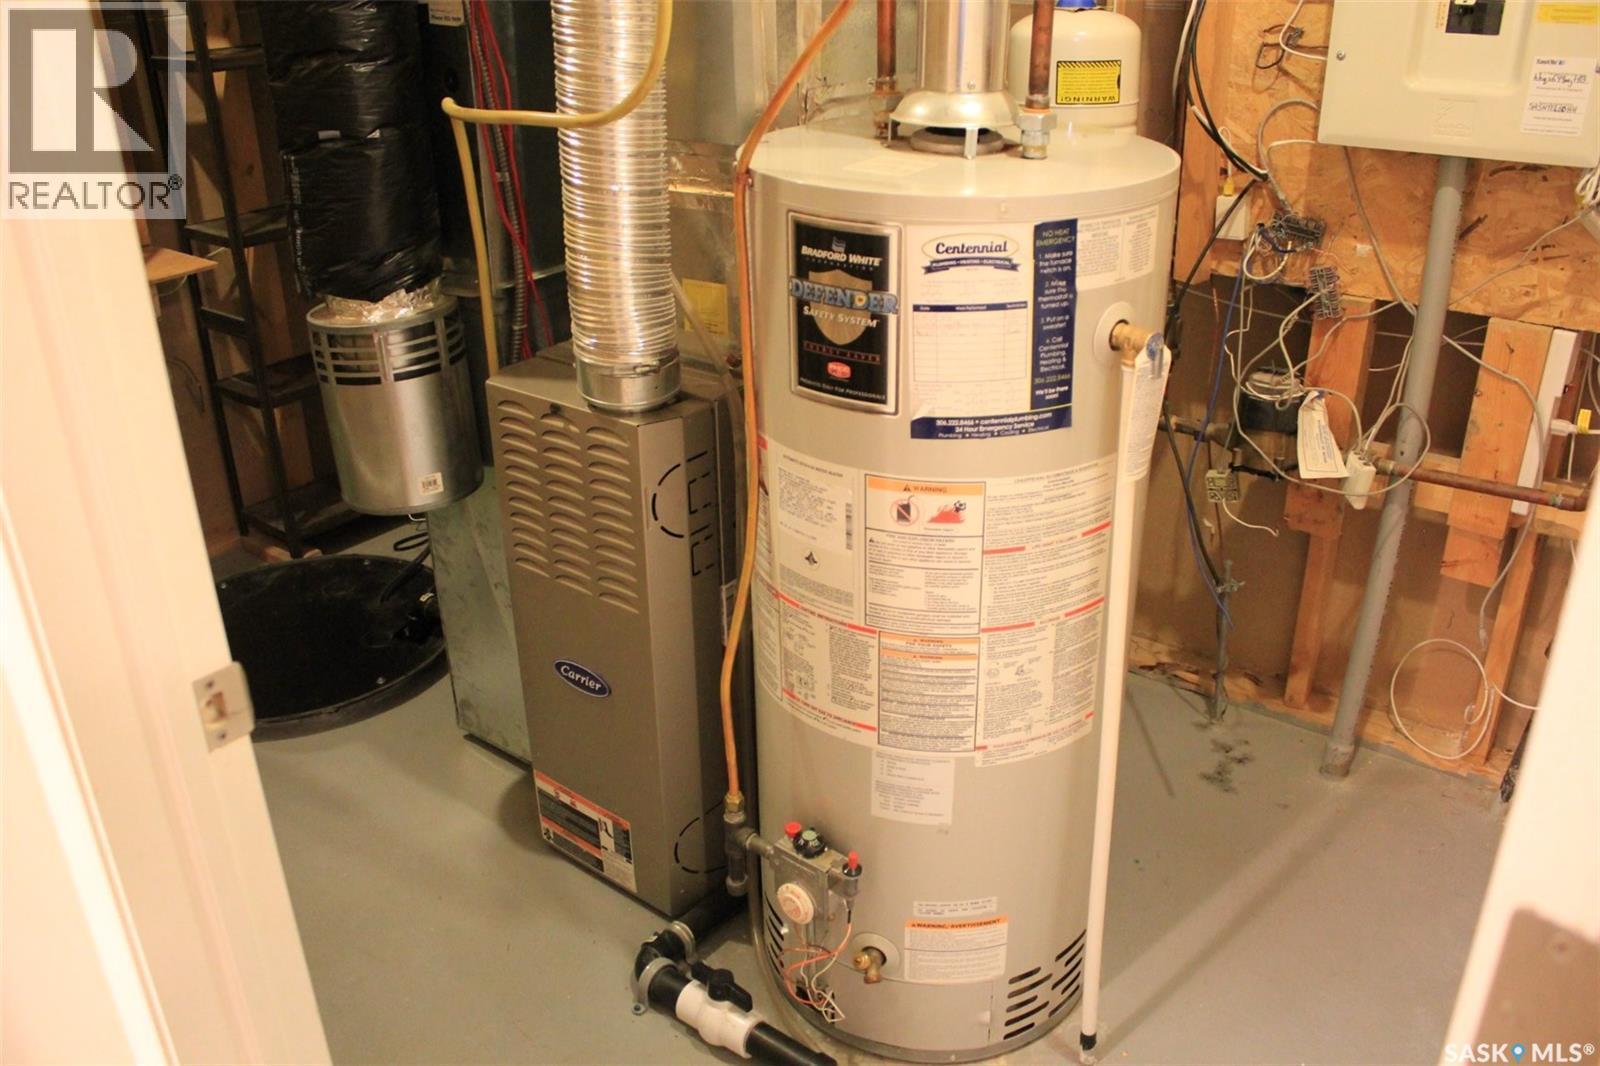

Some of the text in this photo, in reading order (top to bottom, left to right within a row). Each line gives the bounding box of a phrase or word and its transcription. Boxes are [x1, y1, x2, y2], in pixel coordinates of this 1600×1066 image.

[801, 245, 847, 262] BRADFORD
[849, 253, 882, 266] WHITE
[935, 240, 1008, 254] Centennial
[790, 277, 897, 314] DEFENDER
[979, 423, 1013, 433] Emergency
[1013, 421, 1035, 429] Service
[913, 486, 947, 494] WARNING
[560, 665, 602, 691] Carrier
